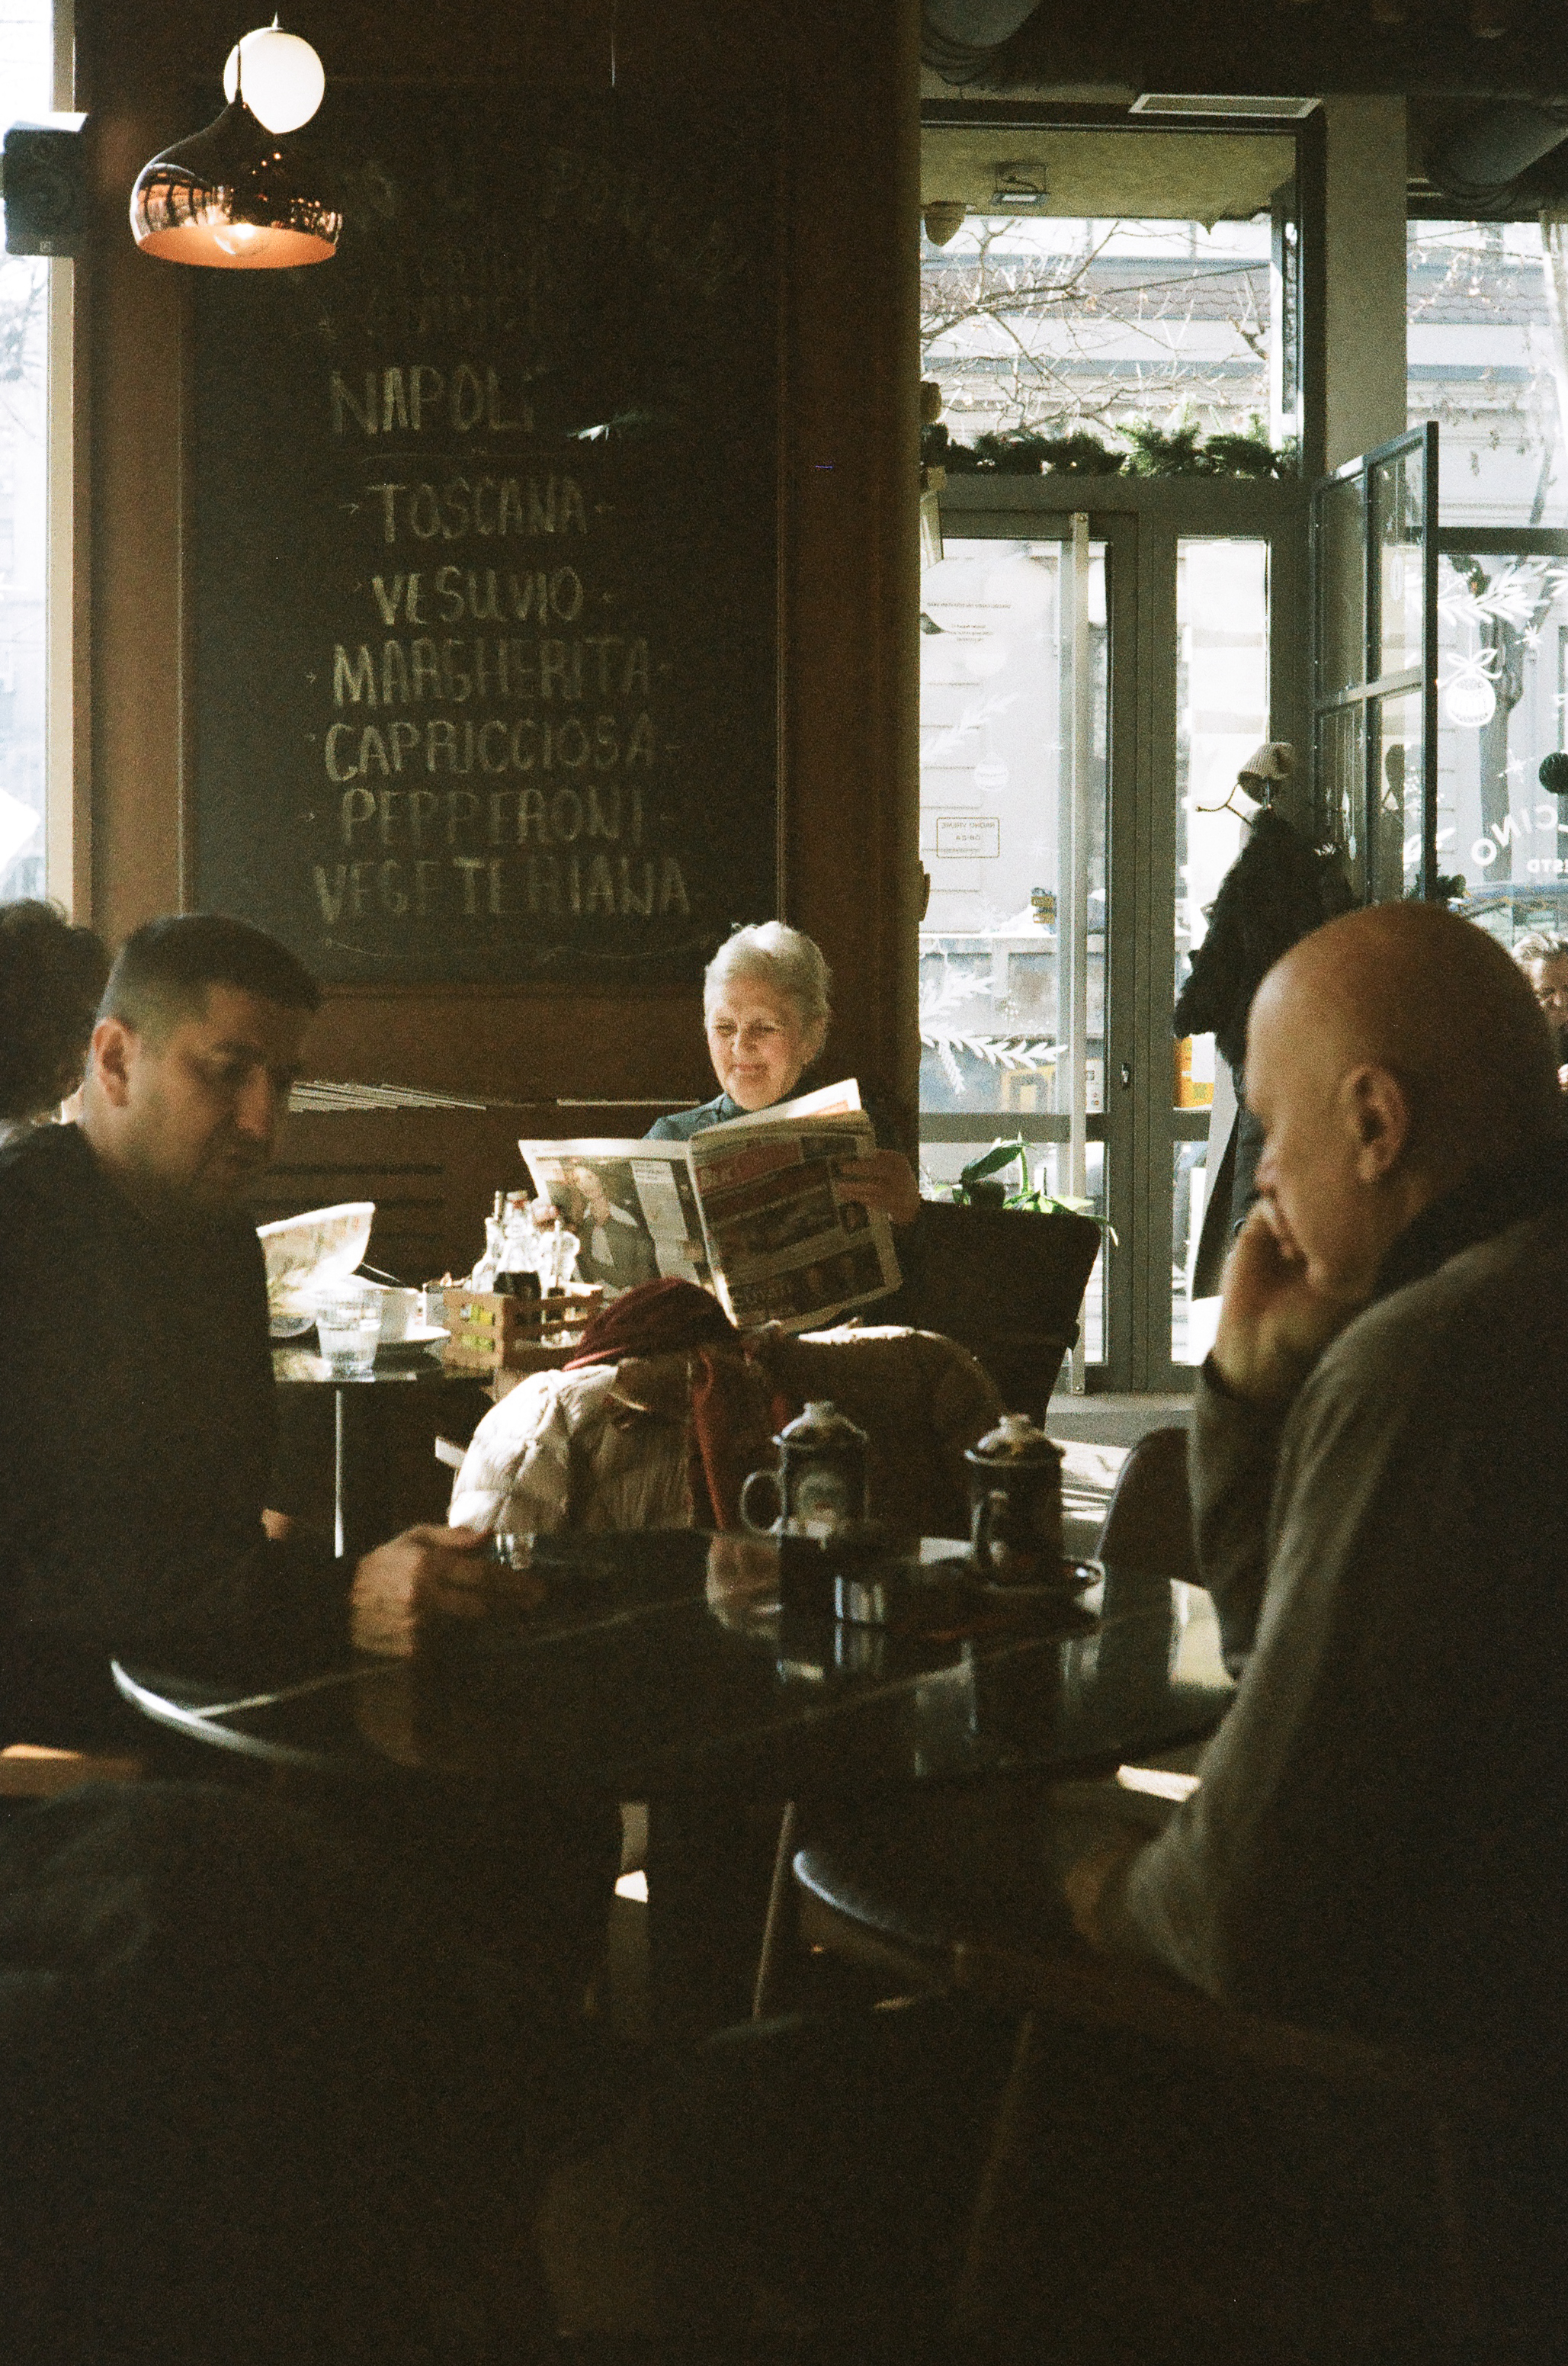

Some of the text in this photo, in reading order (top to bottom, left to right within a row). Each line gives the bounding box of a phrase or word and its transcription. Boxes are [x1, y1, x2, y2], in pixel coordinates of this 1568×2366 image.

[367, 475, 588, 542] TOSCANA
[372, 566, 584, 626] VESUVIO
[332, 637, 650, 708] MARGHERITA
[325, 712, 657, 782] CAPRICCIOSA
[341, 787, 644, 846] PEPPERONI
